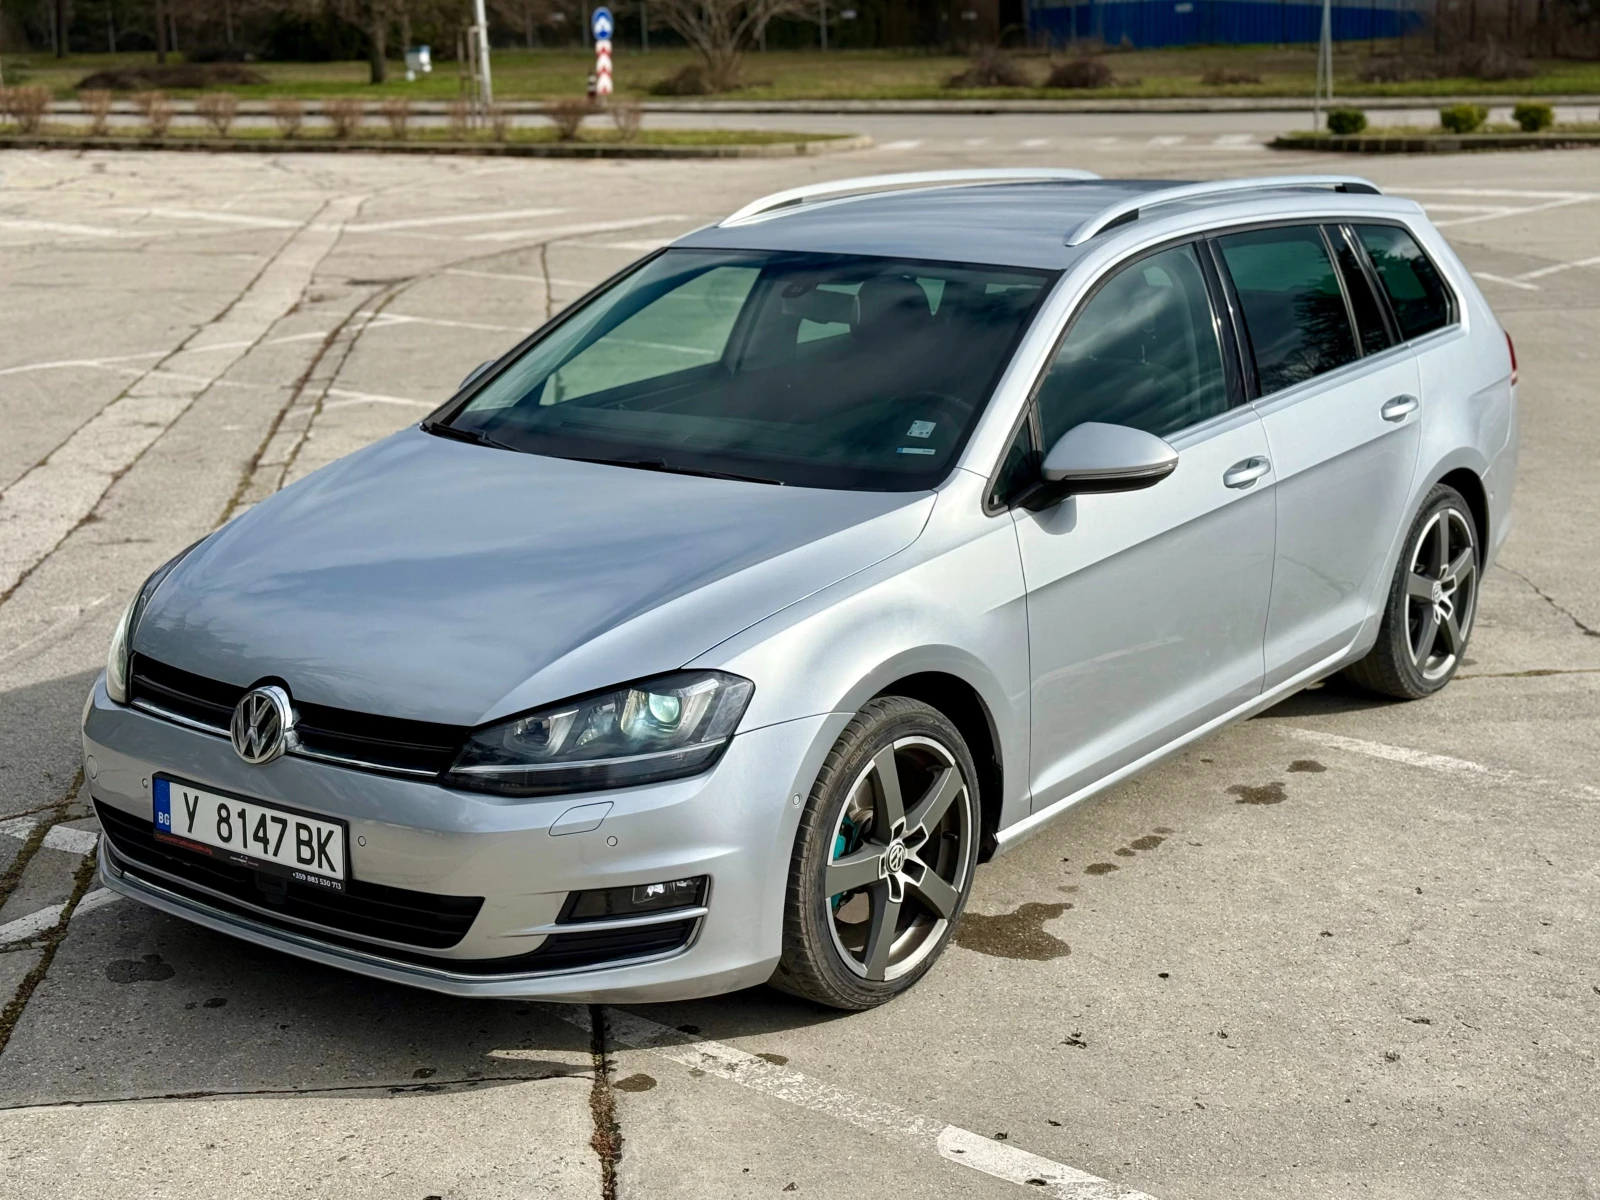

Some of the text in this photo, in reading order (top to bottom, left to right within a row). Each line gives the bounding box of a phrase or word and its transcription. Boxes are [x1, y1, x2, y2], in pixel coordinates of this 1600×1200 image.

[232, 690, 282, 762] VW
[158, 811, 170, 826] BG
[183, 792, 199, 833] Y
[216, 803, 288, 857] 8147
[295, 822, 337, 872] BK
[319, 878, 331, 887] 530
[331, 881, 342, 890] 713
